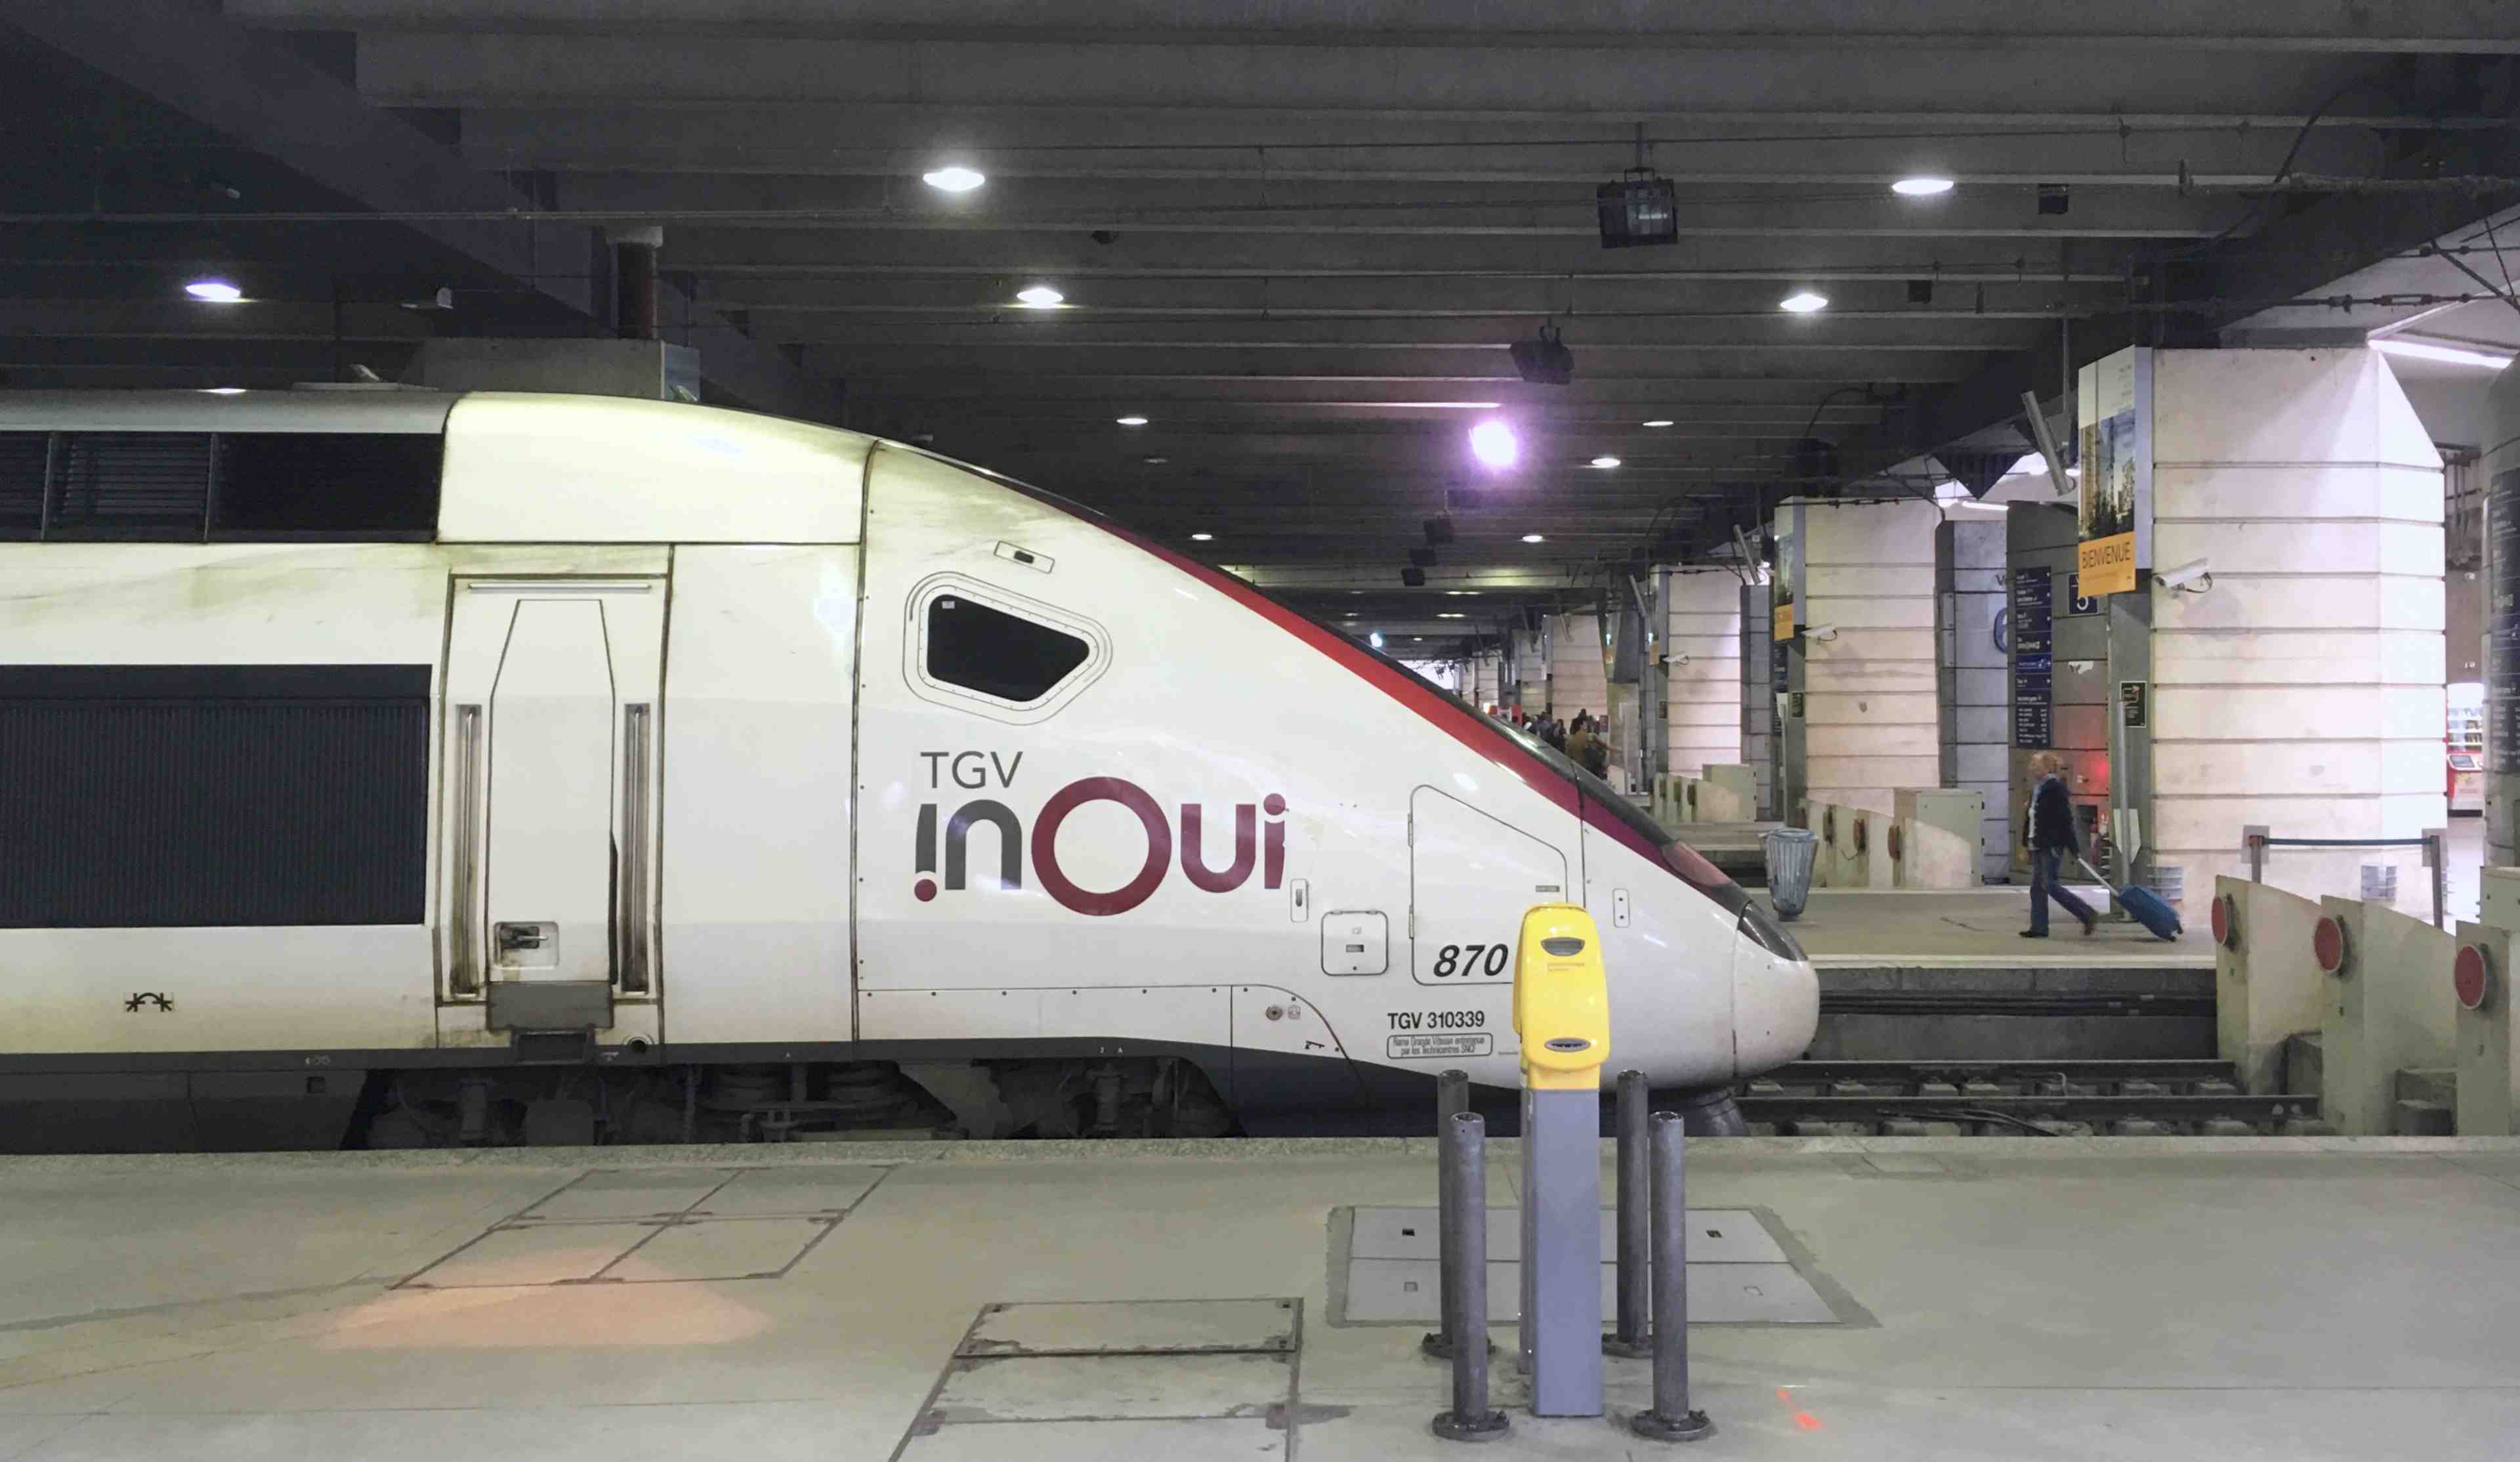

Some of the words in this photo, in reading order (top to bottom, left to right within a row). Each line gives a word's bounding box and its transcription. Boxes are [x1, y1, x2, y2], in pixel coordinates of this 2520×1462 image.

[2082, 541, 2132, 569] BIENVENUE
[920, 751, 1023, 789] TGV
[1433, 943, 1509, 978] 870
[1387, 1013, 1422, 1030] TGV
[1427, 1011, 1485, 1028] 310339
